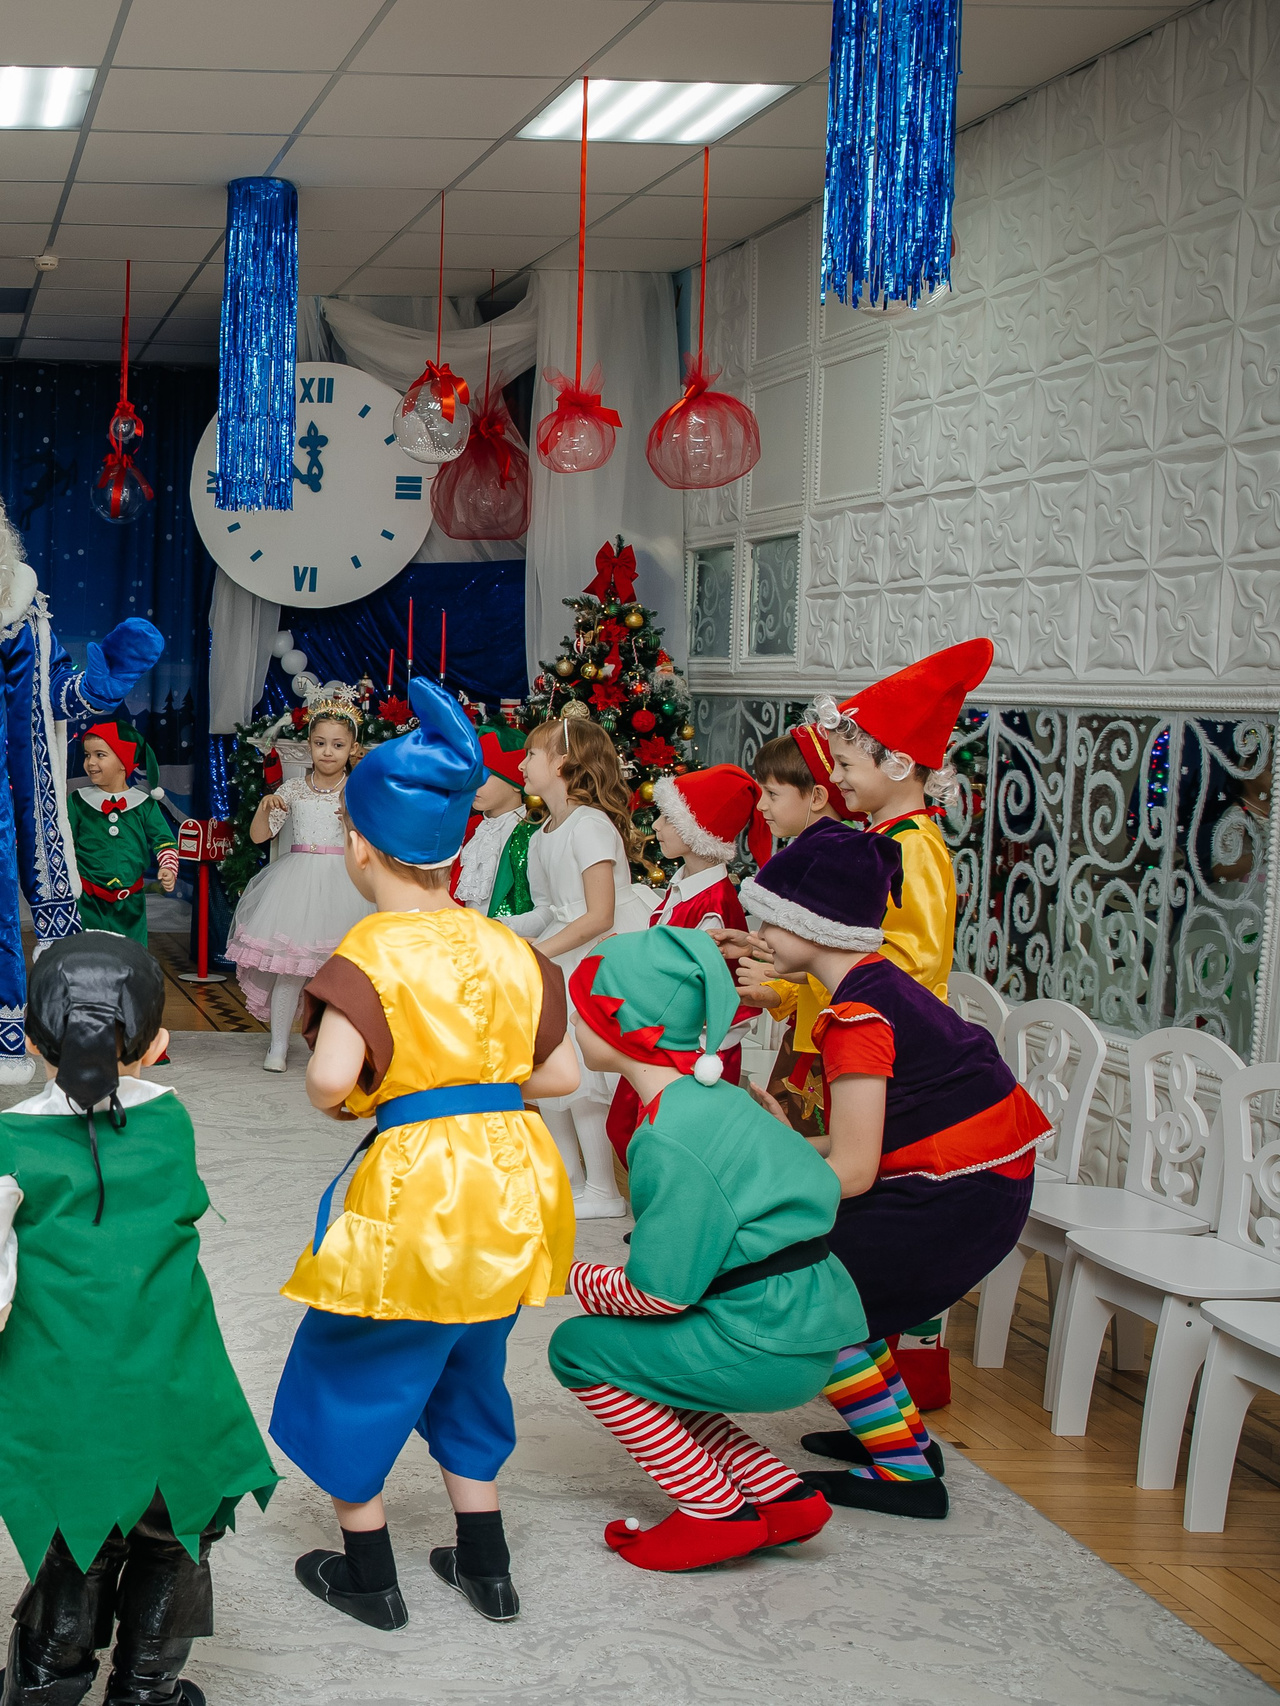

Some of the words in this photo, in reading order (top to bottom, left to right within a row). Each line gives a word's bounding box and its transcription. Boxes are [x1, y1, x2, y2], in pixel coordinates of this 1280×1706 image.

[299, 377, 334, 404] XII
[395, 475, 423, 500] III
[293, 565, 318, 592] VI
